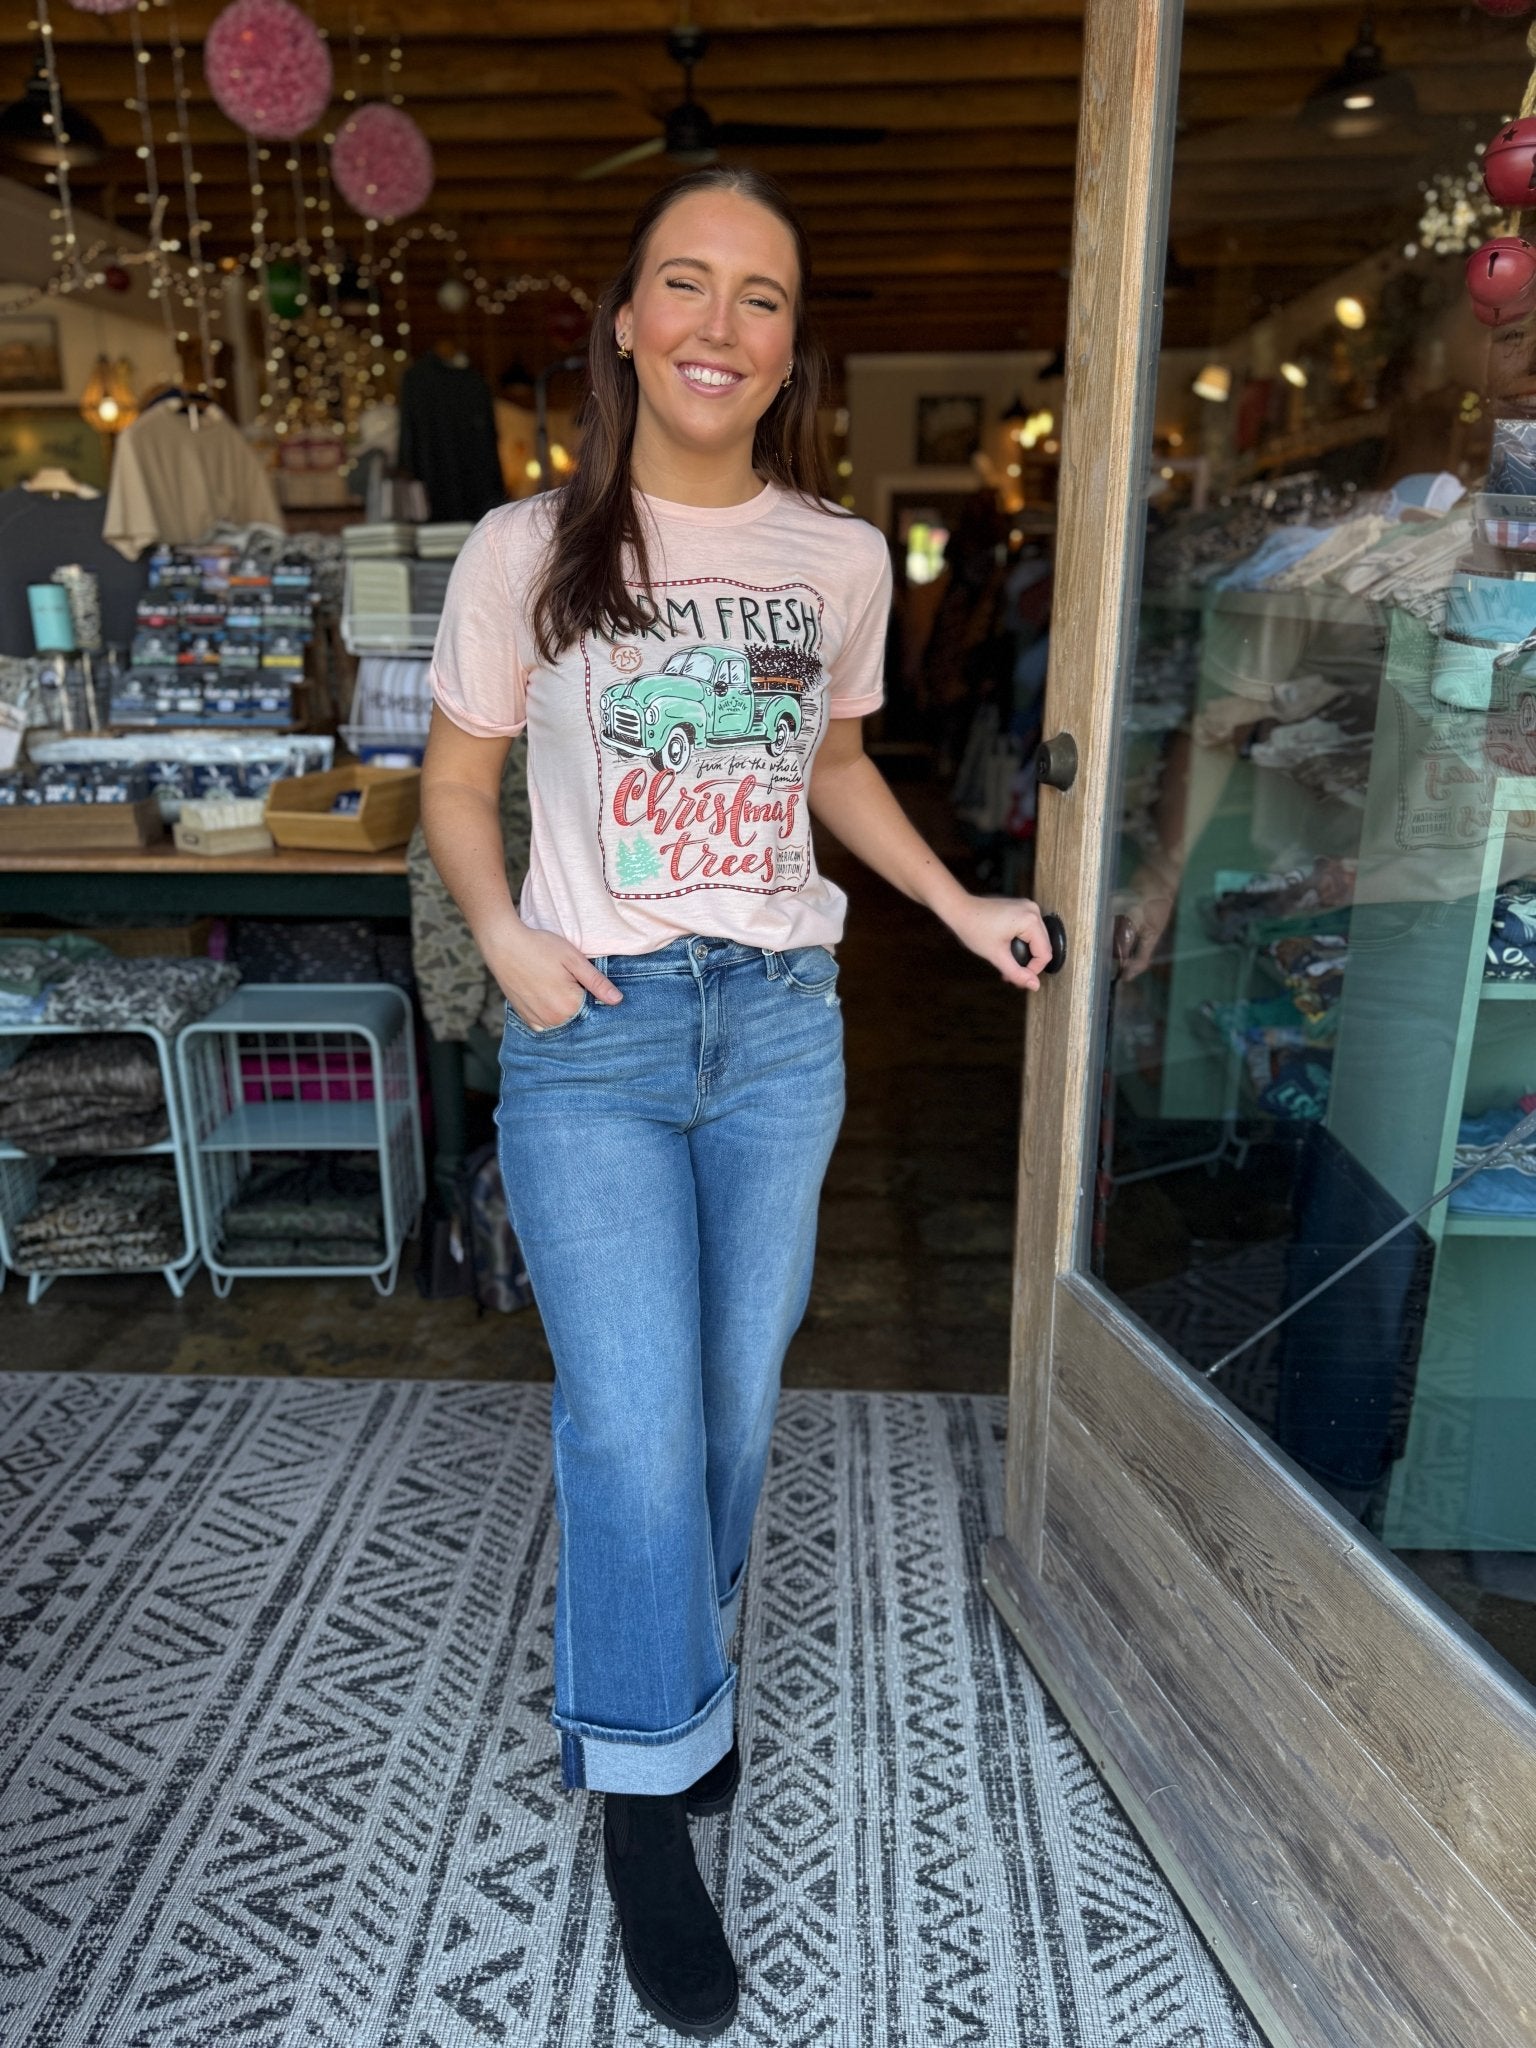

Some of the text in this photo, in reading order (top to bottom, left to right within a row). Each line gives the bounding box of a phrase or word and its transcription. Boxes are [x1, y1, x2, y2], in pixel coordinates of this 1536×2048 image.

[715, 597, 819, 651] FRESH
[728, 755, 746, 776] for
[748, 757, 766, 770] the
[769, 756, 798, 773] whole
[767, 772, 802, 795] family
[613, 767, 804, 847] Christmas
[660, 832, 774, 883] trees
